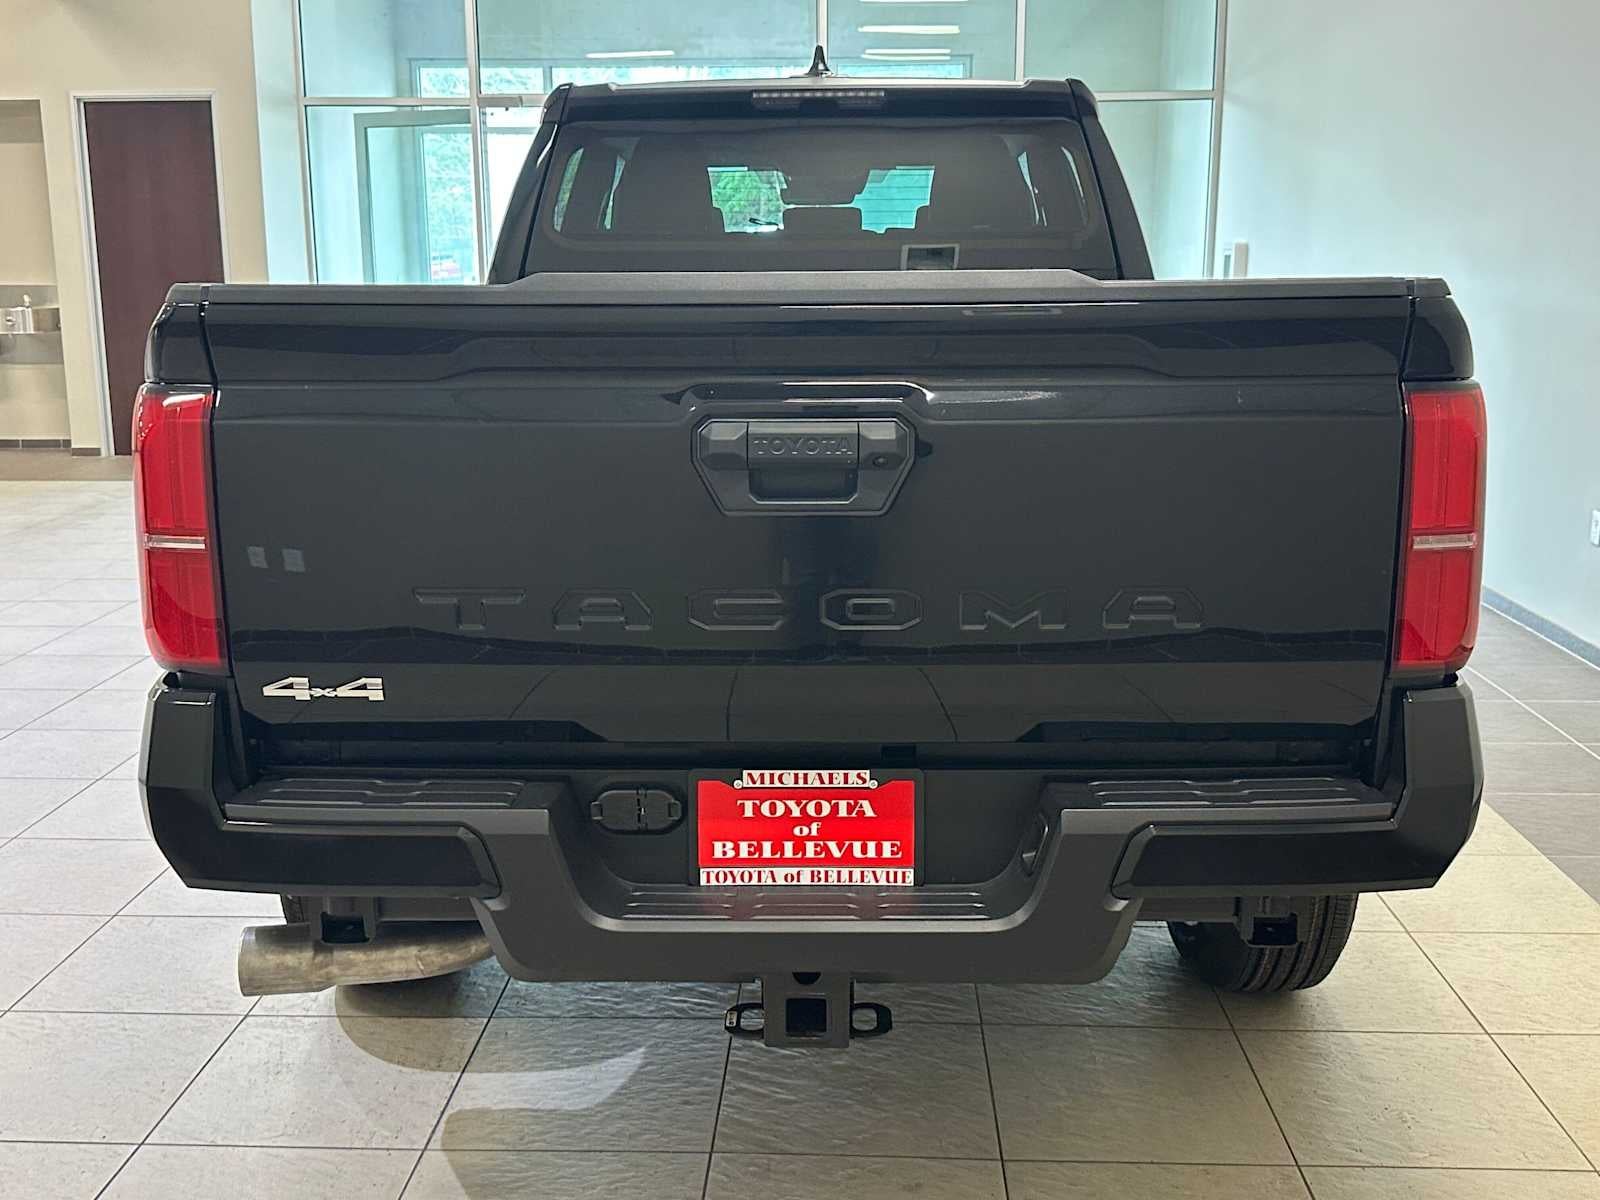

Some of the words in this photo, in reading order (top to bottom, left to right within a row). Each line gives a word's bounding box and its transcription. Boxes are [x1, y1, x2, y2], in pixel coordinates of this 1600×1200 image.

[753, 438, 853, 455] TOYOTA
[412, 586, 1203, 631] TACOMA
[746, 771, 868, 786] MICHAELS
[736, 799, 878, 818] TOYOTA
[792, 821, 822, 837] of
[711, 840, 902, 859] BELLEVUE
[702, 869, 777, 884] TOYOTA
[783, 869, 802, 884] of
[809, 869, 913, 885] BELLEVUE
